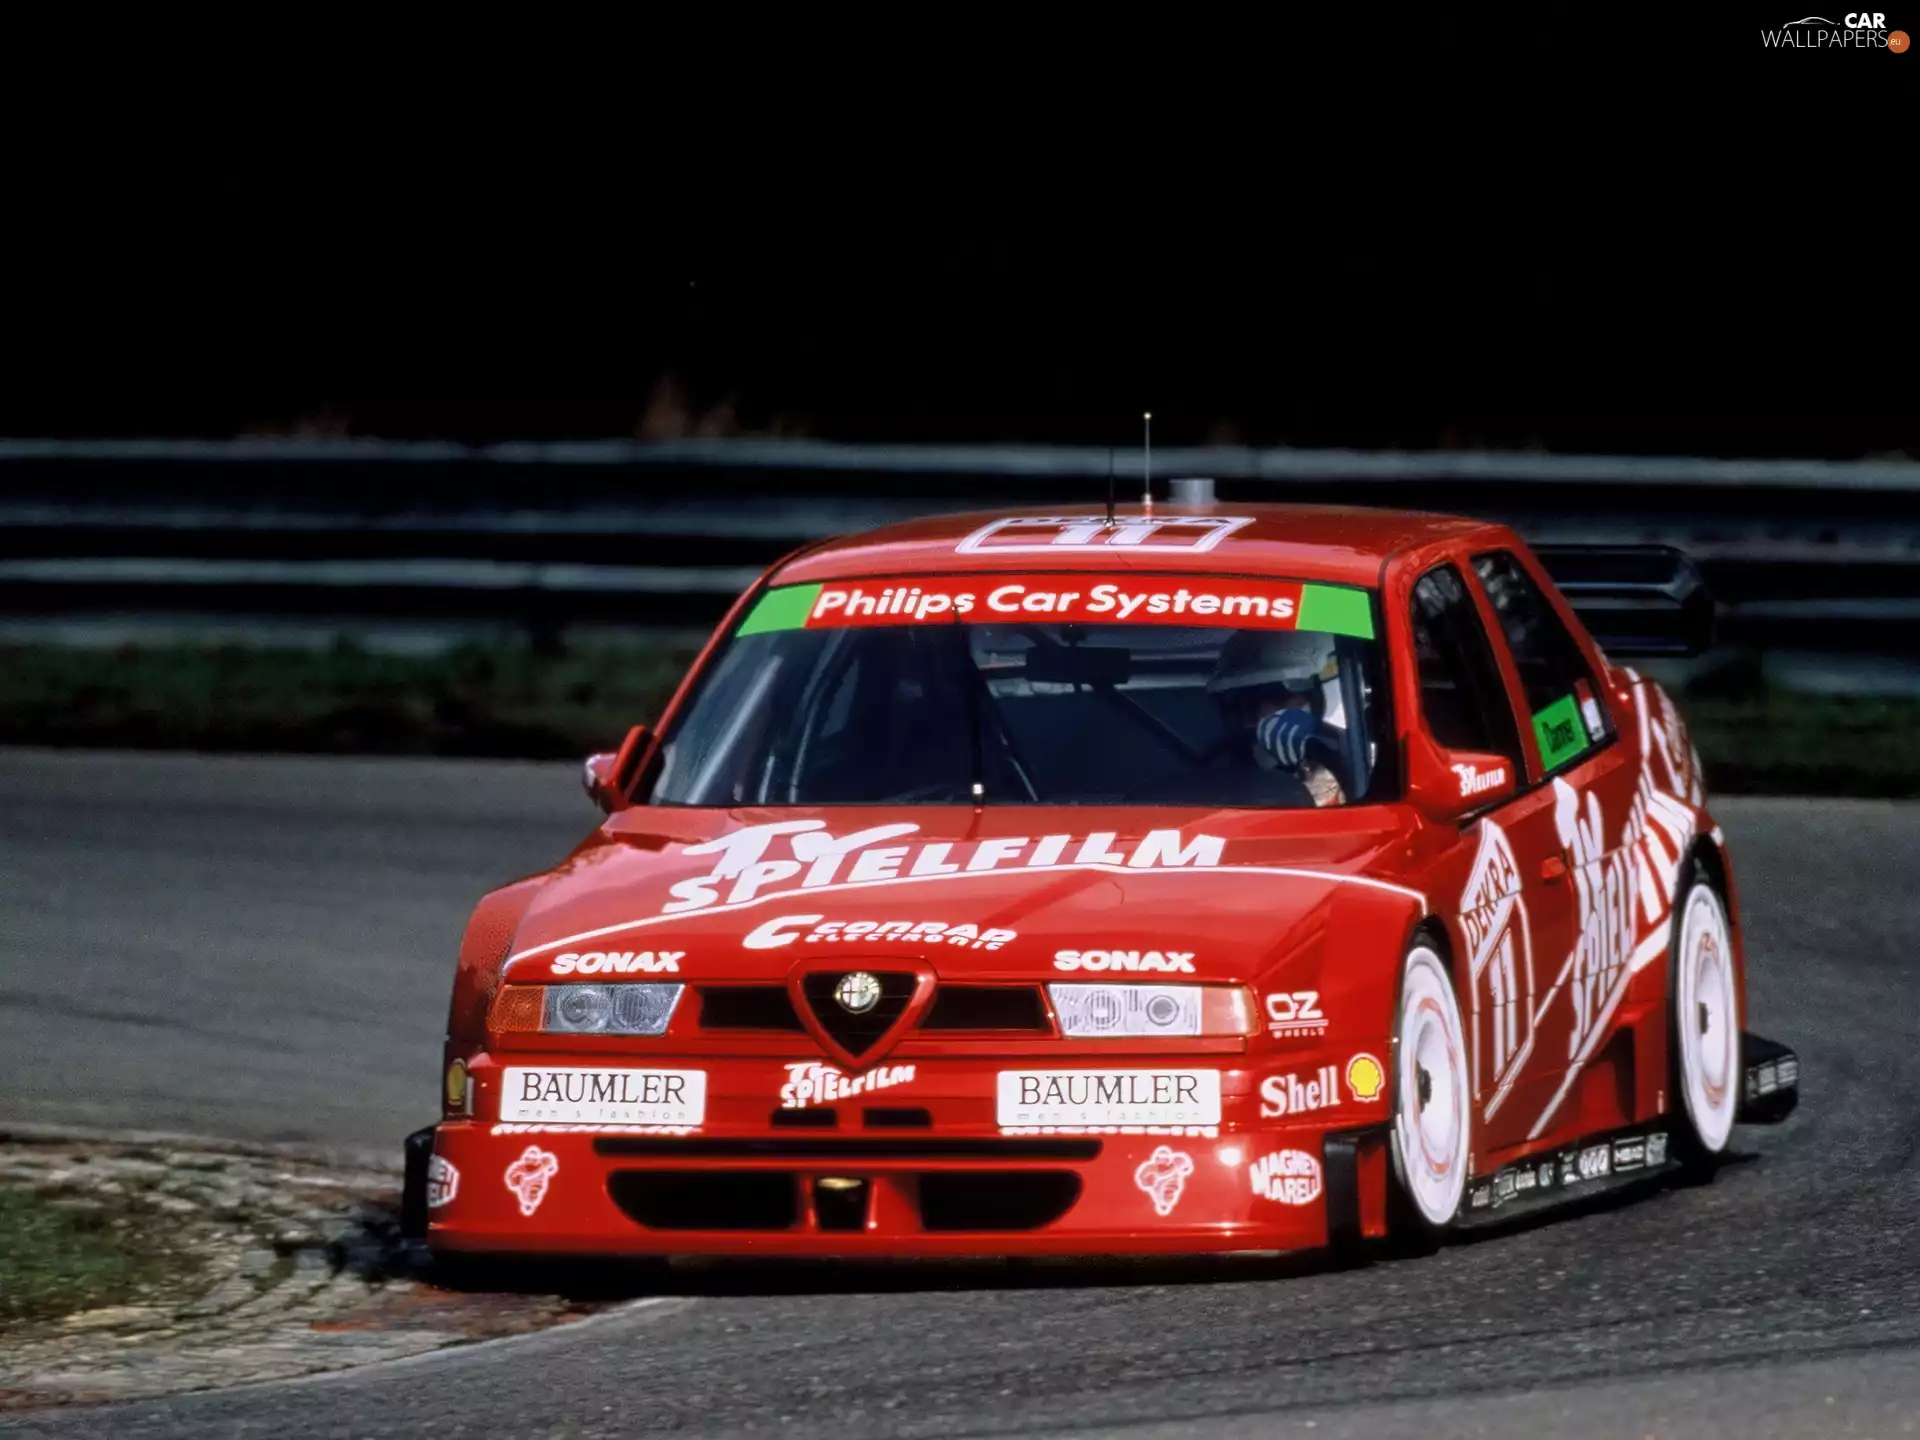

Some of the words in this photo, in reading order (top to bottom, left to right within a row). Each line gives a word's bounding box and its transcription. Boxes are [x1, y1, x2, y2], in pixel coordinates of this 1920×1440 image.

[813, 588, 974, 619] Philips
[987, 585, 1079, 613] Car
[1086, 584, 1294, 619] Systems
[662, 829, 1226, 913] SPIELFILM
[1464, 839, 1515, 956] DEKRA
[551, 951, 685, 974] SONAX
[1054, 950, 1196, 973] SONAX
[1260, 1065, 1342, 1118] Shell
